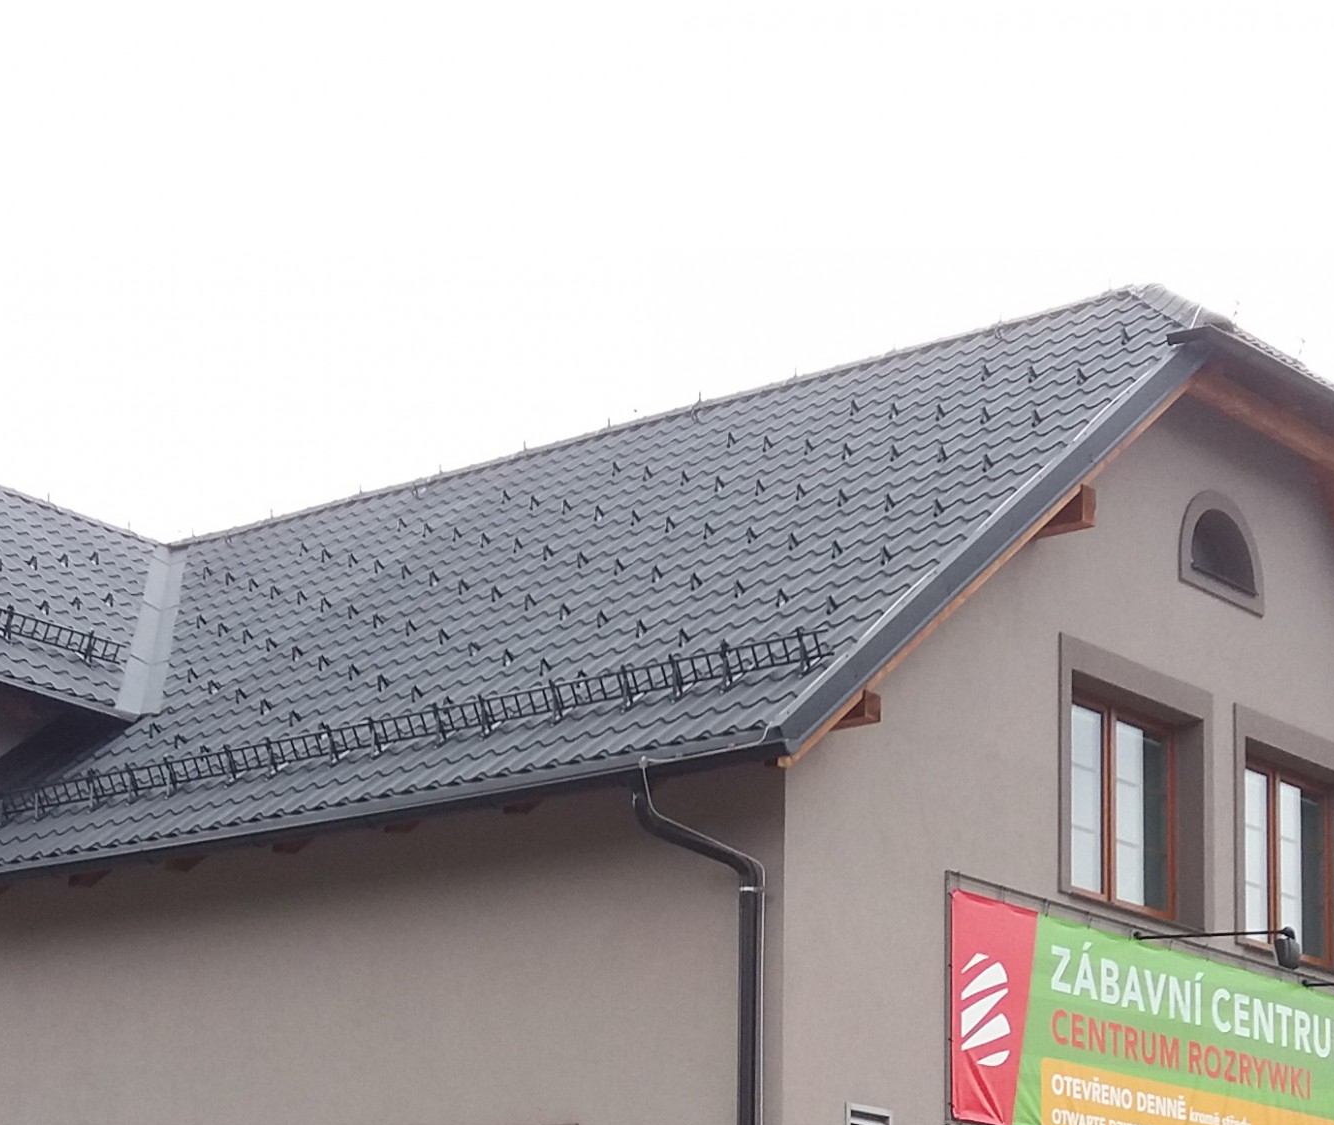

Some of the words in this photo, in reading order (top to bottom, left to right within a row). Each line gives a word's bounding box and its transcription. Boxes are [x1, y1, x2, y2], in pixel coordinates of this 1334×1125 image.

[1050, 942, 1204, 1026] ZÁBAVNÍ
[1051, 1009, 1180, 1070] CENTRUM
[1188, 1041, 1312, 1100] ROZRYWKI
[1051, 1073, 1133, 1110] OTEVŘENO
[1136, 1091, 1187, 1120] DENNĚ
